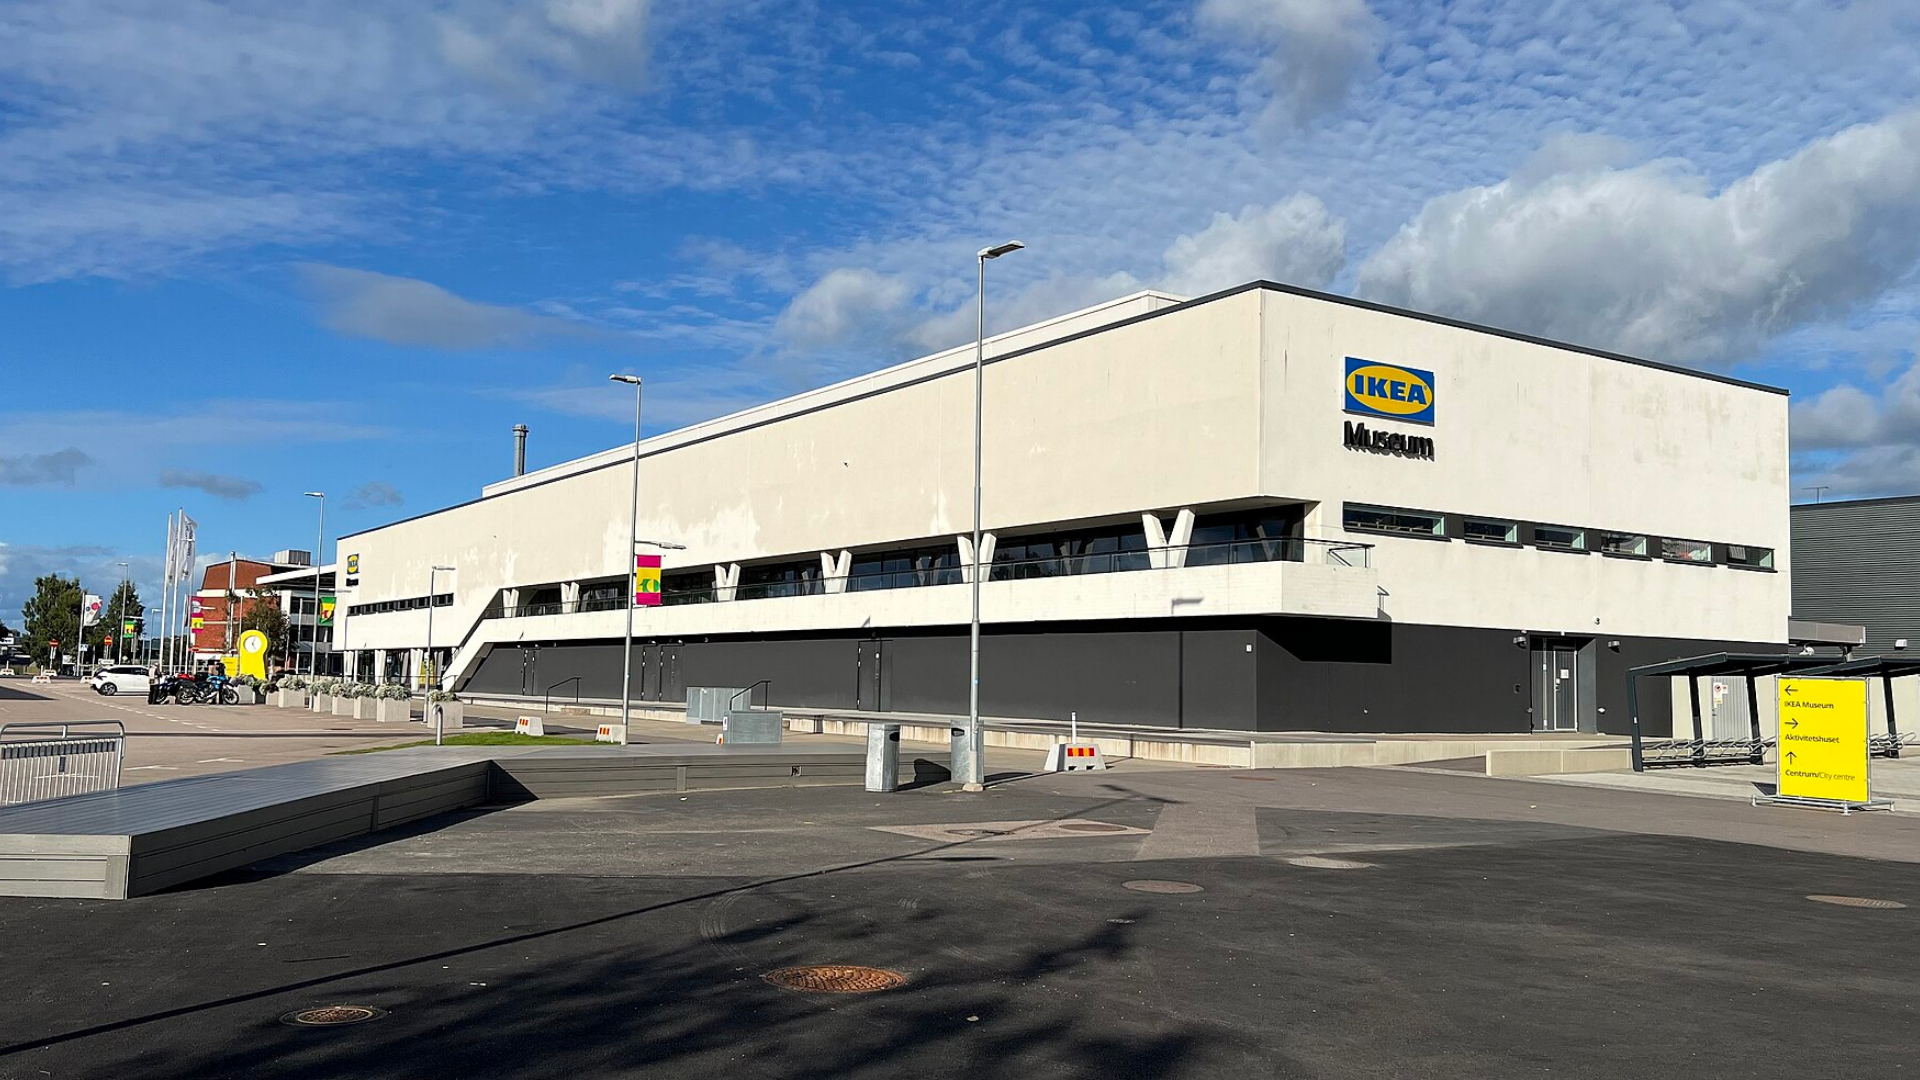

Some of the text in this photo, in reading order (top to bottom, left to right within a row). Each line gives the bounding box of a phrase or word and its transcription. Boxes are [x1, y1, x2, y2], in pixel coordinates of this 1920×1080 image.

[1354, 373, 1427, 406] IKEA
[1343, 420, 1435, 461] Museum
[1802, 701, 1834, 709] Museum
[1785, 733, 1840, 743] Aktivitetshuset
